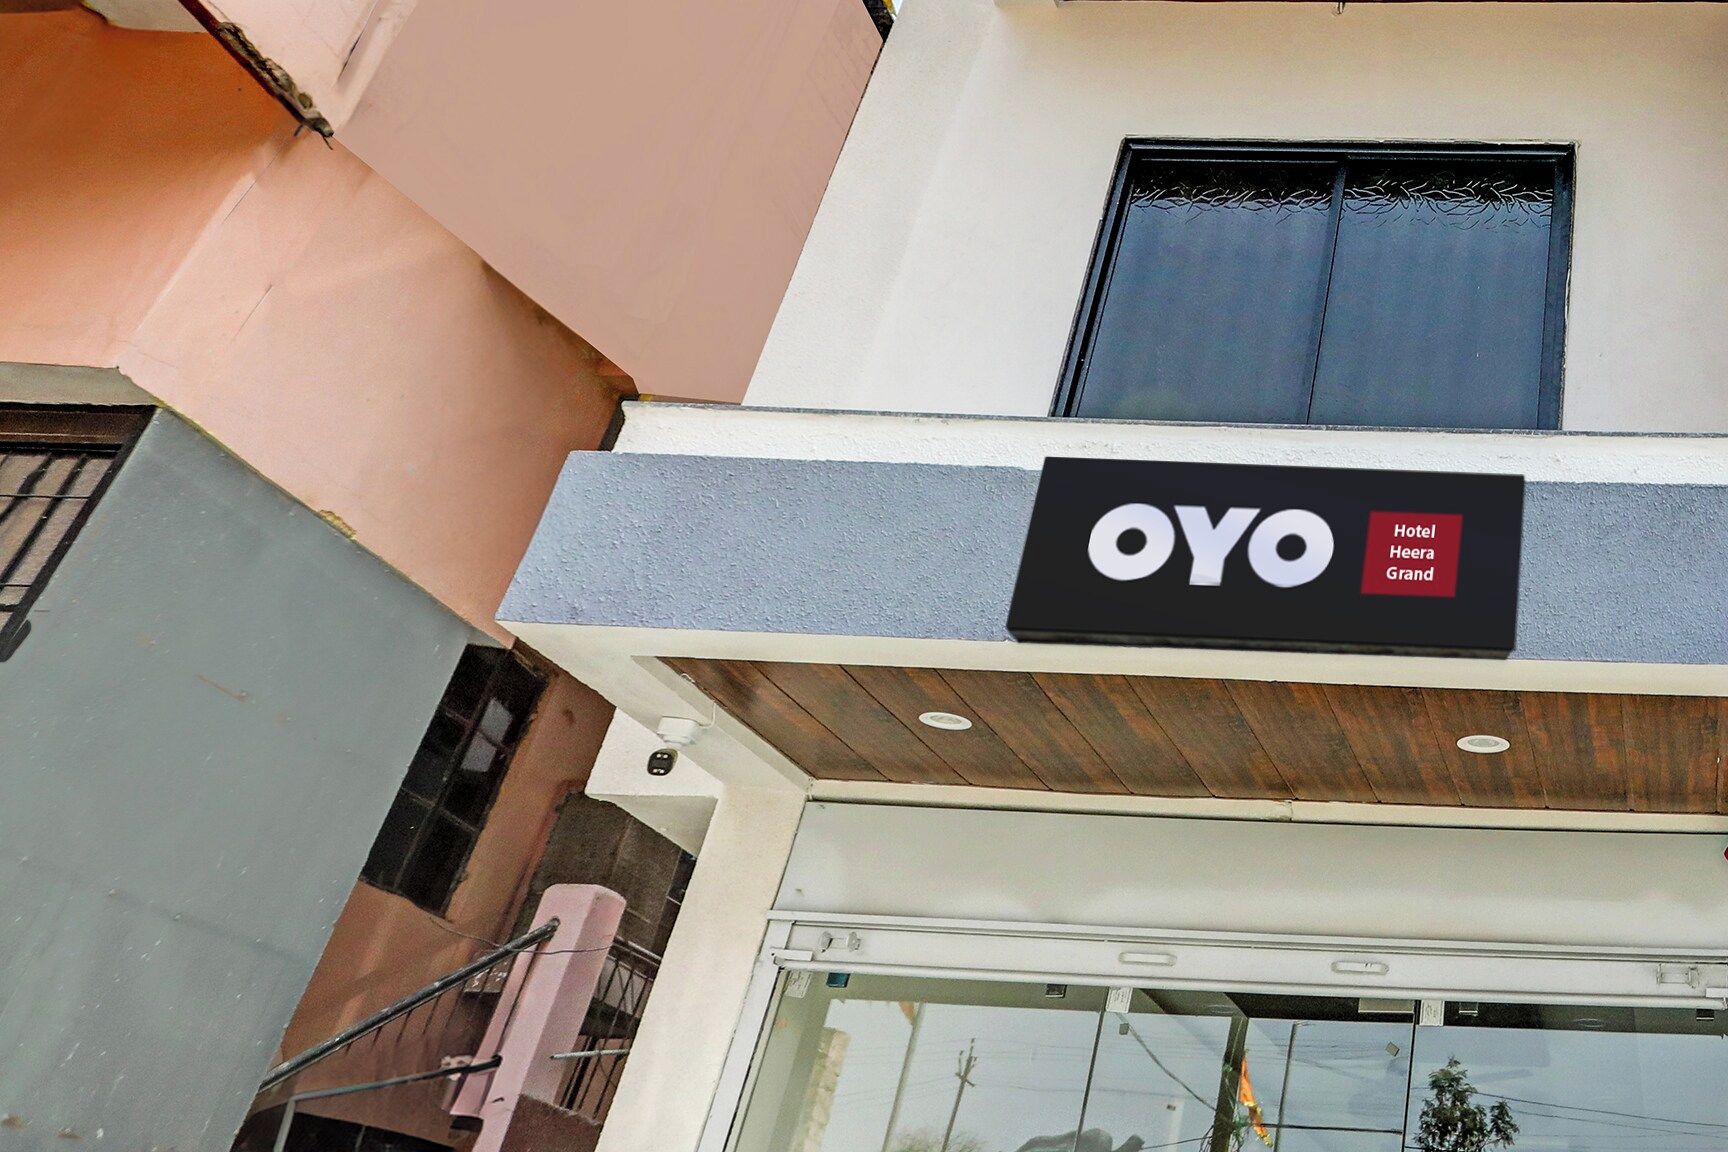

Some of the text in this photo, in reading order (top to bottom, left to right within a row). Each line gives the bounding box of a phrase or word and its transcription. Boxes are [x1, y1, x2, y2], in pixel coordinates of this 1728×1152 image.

[1393, 522, 1437, 539] Hotel
[1087, 502, 1335, 588] OYO
[1389, 543, 1435, 560] Heera
[1386, 564, 1435, 582] Grand
